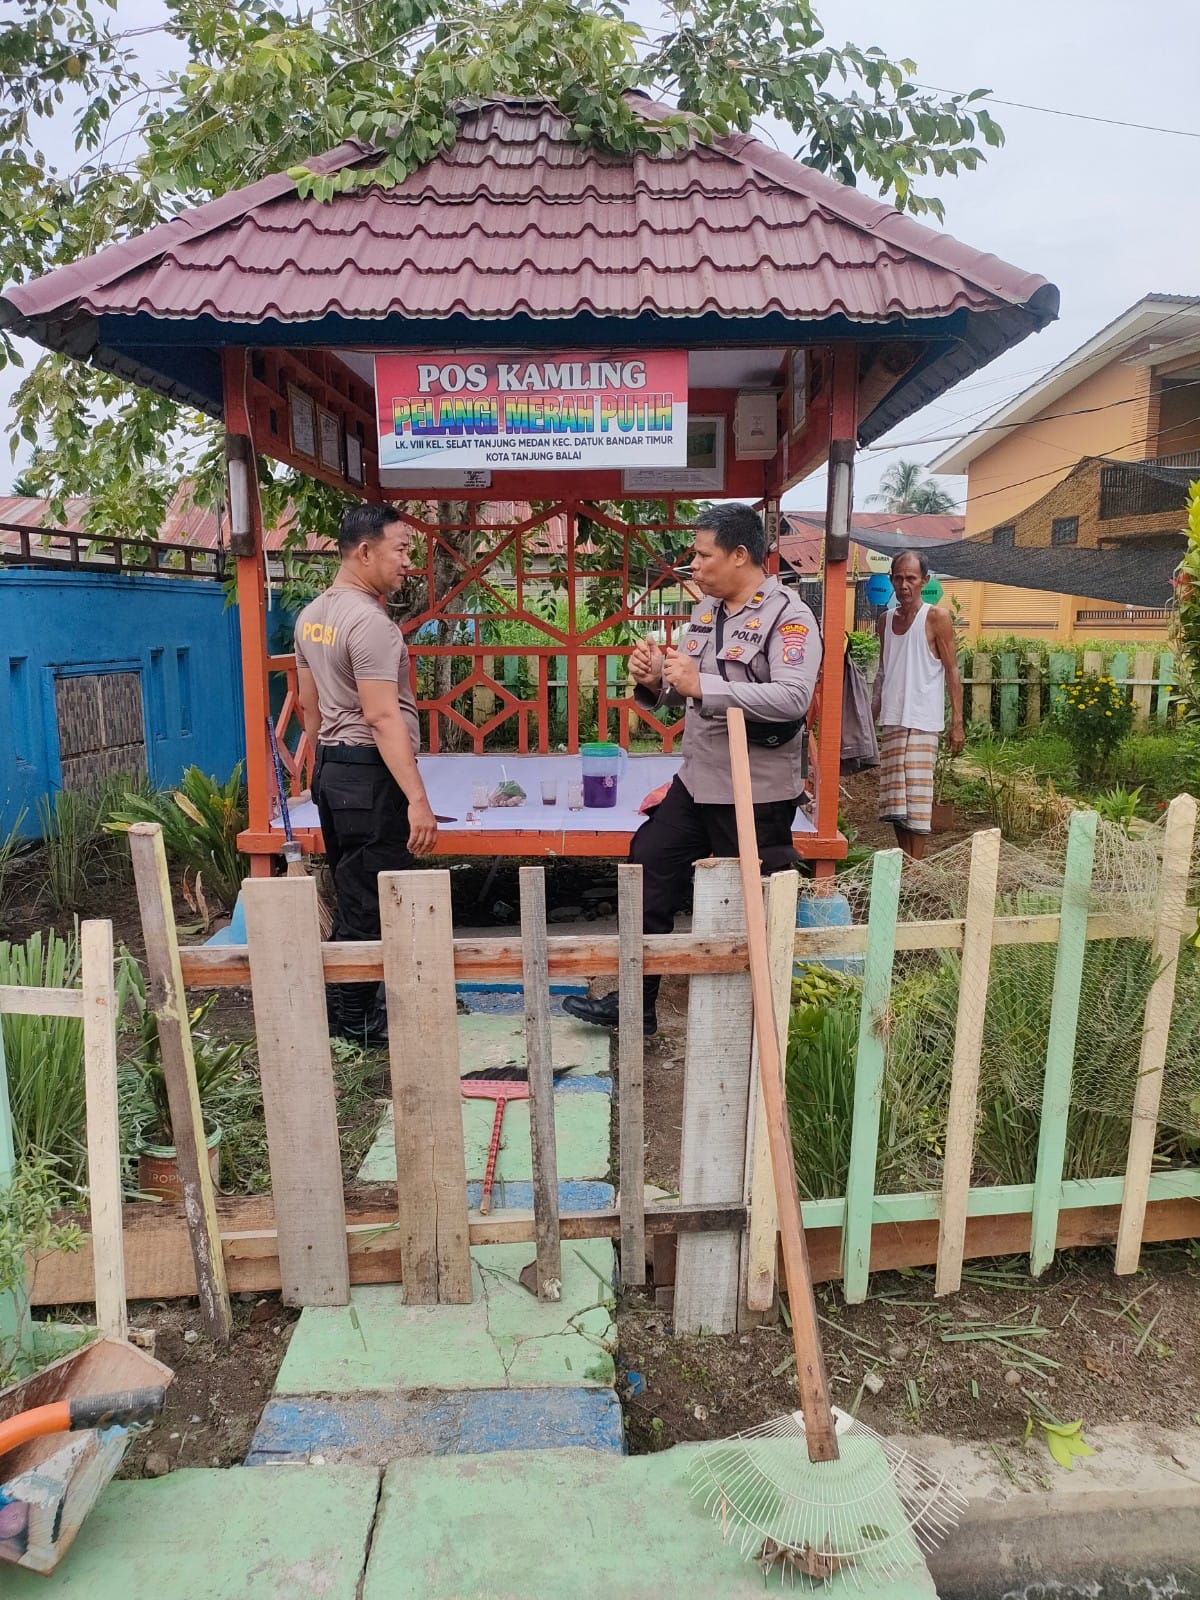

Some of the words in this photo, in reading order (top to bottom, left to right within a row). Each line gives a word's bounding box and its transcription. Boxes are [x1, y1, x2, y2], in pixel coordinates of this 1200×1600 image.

[417, 364, 488, 393] POS
[496, 361, 647, 392] KAMLING
[392, 396, 500, 436] PELANGI
[504, 394, 595, 434] MERAH
[600, 393, 673, 432] PUTIH
[395, 441, 408, 449] LK.
[410, 440, 424, 449] VIII
[425, 440, 444, 449] KEL.
[446, 440, 472, 449] SELAT
[473, 440, 516, 449] TANJUNG
[518, 439, 550, 448] MEDAN
[552, 438, 572, 447] KEC.
[574, 438, 604, 447] DATUK
[606, 437, 643, 446] BANDAR
[645, 437, 673, 445] TIMUR
[486, 453, 509, 462] KOTA
[511, 452, 554, 462] TANJUNG
[556, 452, 582, 461] BALAI
[731, 629, 763, 645] POLRI
